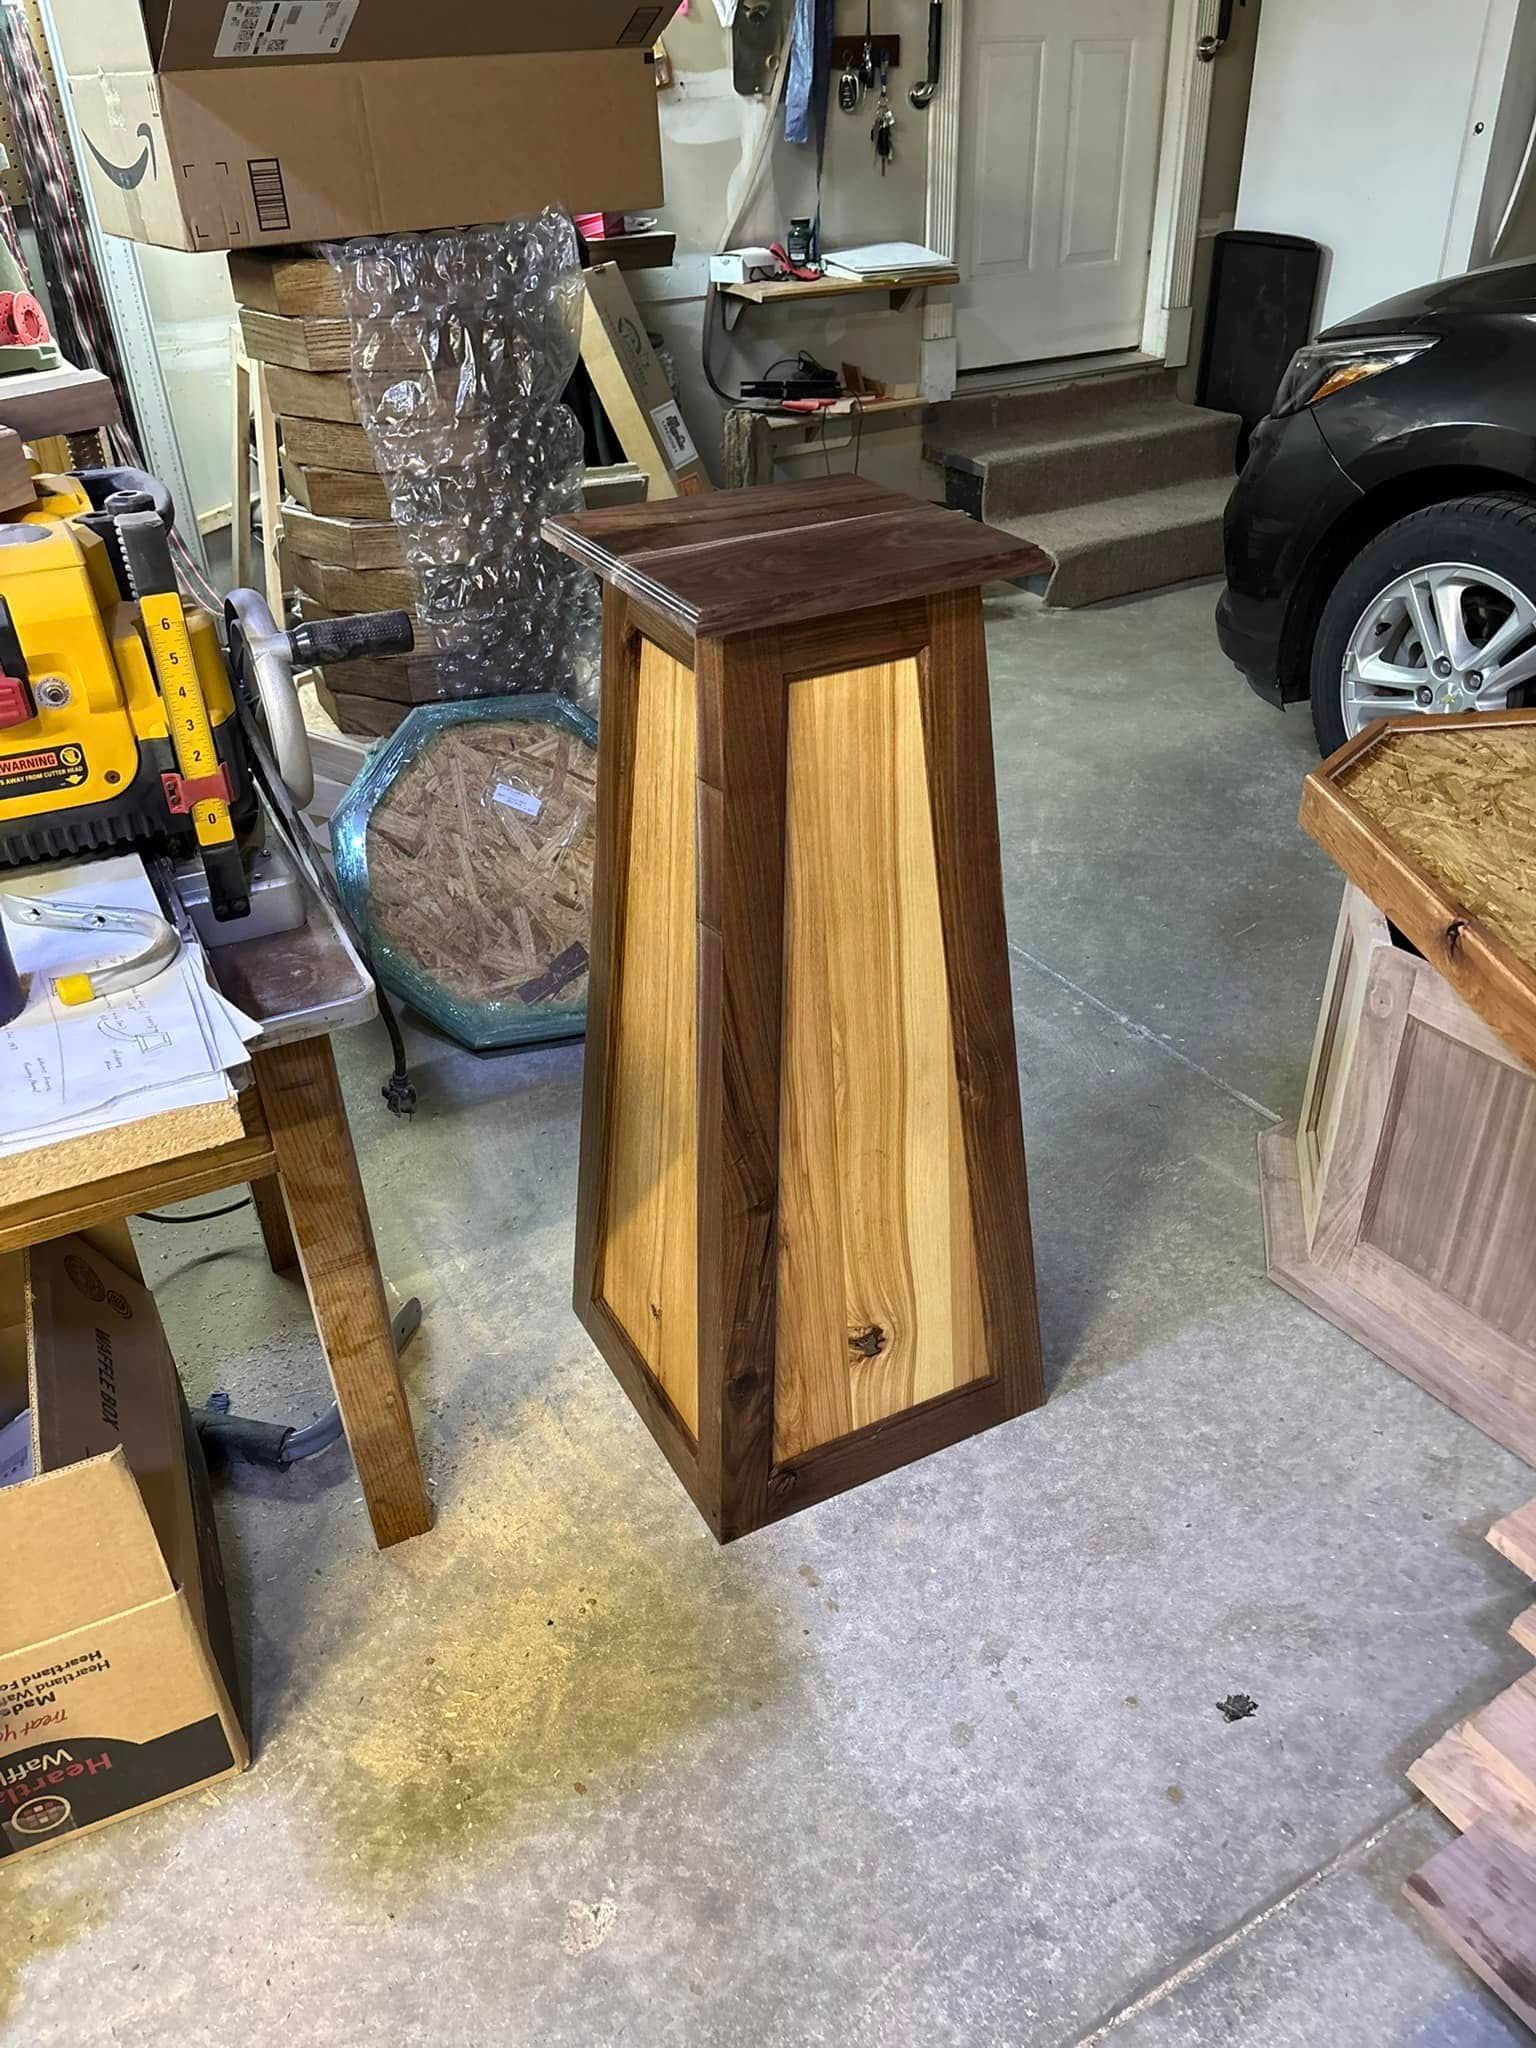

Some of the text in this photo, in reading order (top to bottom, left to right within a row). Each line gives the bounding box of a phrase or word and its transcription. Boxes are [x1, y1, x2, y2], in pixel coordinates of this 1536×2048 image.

[161, 617, 171, 631] 6
[169, 652, 179, 666] 5
[178, 686, 187, 699] 4
[186, 719, 195, 731] 3
[0, 754, 56, 773] WARNING
[193, 750, 201, 762] 2
[6, 776, 25, 785] AWAY
[25, 772, 43, 782] FROM
[43, 769, 66, 778] CUTTER
[67, 766, 84, 774] HEAD
[208, 813, 217, 825] 0
[95, 1328, 120, 1432] WAFFLE BOX
[21, 1650, 102, 1686] Heartland
[36, 1659, 110, 1694] Heartland
[0, 1691, 56, 1717] Made
[20, 1708, 68, 1735] Treat
